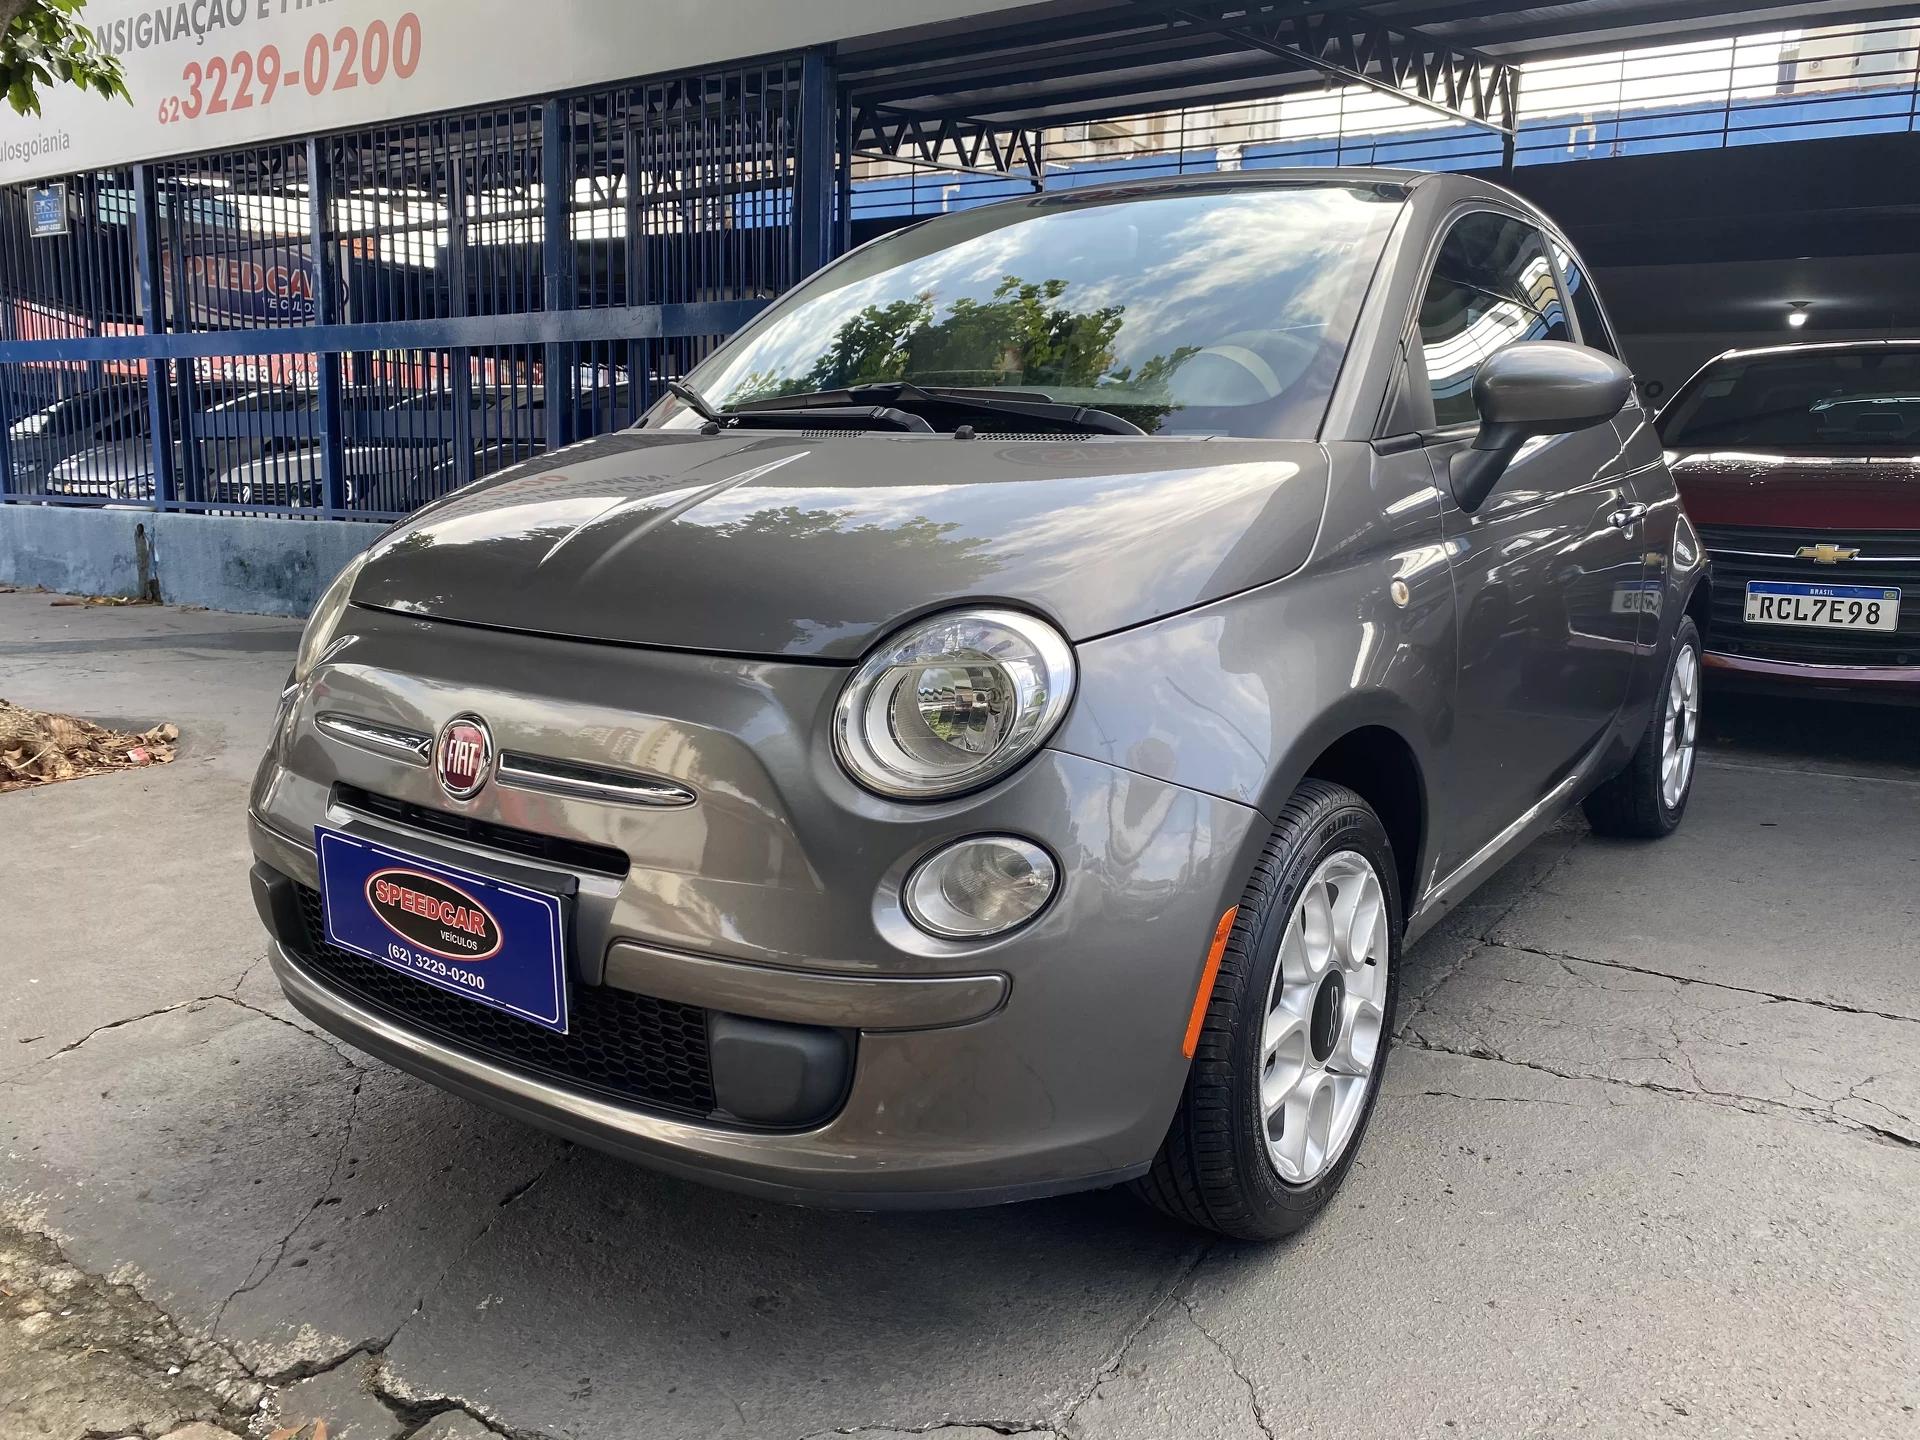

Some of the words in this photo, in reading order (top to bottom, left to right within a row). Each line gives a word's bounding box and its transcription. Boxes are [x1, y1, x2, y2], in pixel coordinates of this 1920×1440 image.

[158, 96, 180, 124] 62
[181, 12, 422, 119] 3229-0200
[1759, 597, 1881, 625] RCL7E98
[1810, 588, 1834, 596] BRASIL
[447, 739, 479, 777] FIAT
[376, 880, 486, 938] SPEEDCAR
[440, 930, 478, 951] VEÍCULOS
[388, 943, 412, 966] (62)
[415, 954, 485, 990] 3229-0200
